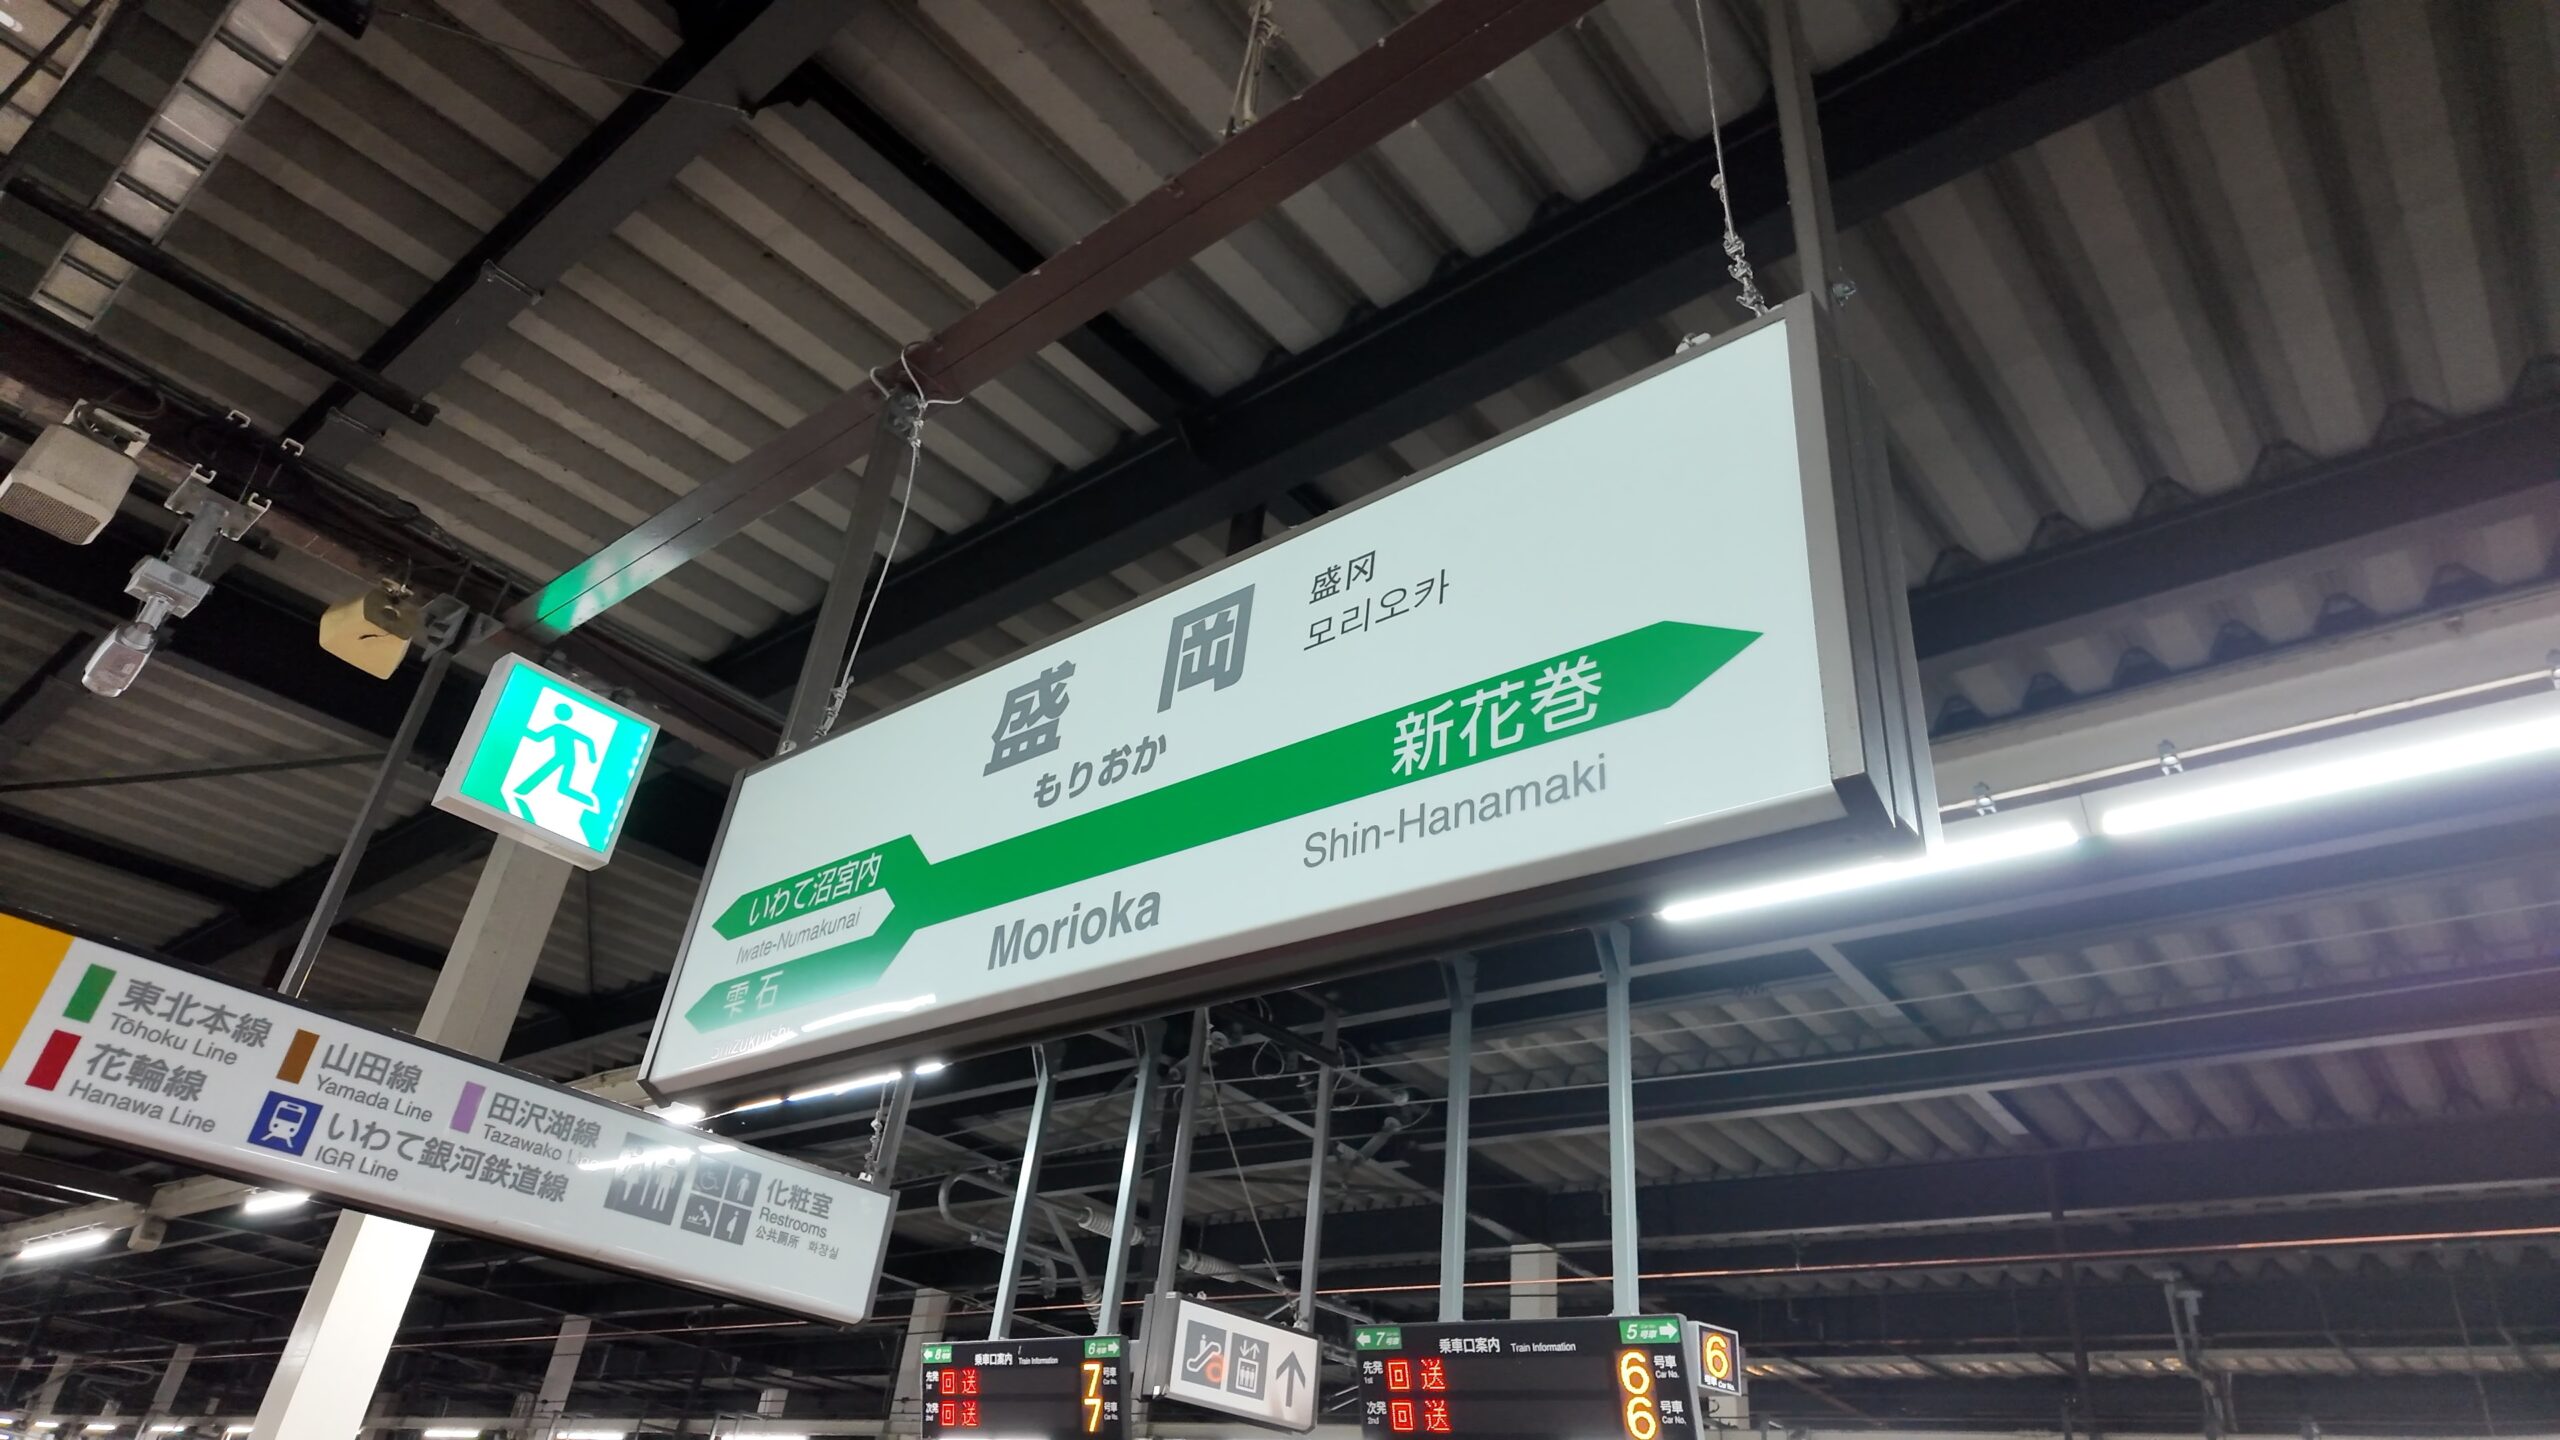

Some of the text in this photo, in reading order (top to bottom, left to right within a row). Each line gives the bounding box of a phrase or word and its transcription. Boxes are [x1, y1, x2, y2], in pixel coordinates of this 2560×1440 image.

[1309, 550, 1376, 604] 盛冈
[1303, 569, 1450, 651] 모리오카
[982, 583, 1256, 777] 盛岡
[1391, 655, 1602, 777] 新花巻
[1033, 733, 1167, 808] もりおか
[1303, 753, 1607, 868] Shin-Hanamaki
[749, 852, 883, 926] いわて沼宮内
[736, 907, 862, 965] Iwate-Numakunai
[987, 890, 1162, 971] Morioka
[118, 978, 274, 1048] 東北本線
[110, 1012, 238, 1066] Tōhoku Line
[87, 1043, 208, 1101] 花輪線
[320, 1043, 423, 1095] 山田線
[68, 1080, 216, 1133] Hanawa Line
[316, 1074, 433, 1123] Yamada Line
[487, 1091, 602, 1149] 田沢湖線
[327, 1112, 569, 1202] いわて銀河鉄道線
[483, 1123, 562, 1161] Tazawako
[315, 1145, 399, 1182] IGR Line
[767, 1178, 833, 1219] 化粧室
[759, 1206, 827, 1238] Restrooms
[1088, 1342, 1096, 1355] 6
[1376, 1332, 1385, 1346] 7
[1439, 1337, 1577, 1354] 乗車口案内 Train Information
[1627, 1324, 1638, 1339] 5
[1363, 1360, 1383, 1375] 先発
[1387, 1359, 1446, 1390] 回送
[1620, 1351, 1650, 1395] 6
[1654, 1355, 1677, 1369] 号車
[1655, 1370, 1667, 1378] Car
[1705, 1334, 1729, 1379] 6
[941, 1369, 977, 1394] 回送
[1083, 1364, 1101, 1397] 7
[941, 1401, 977, 1426] 回送
[1084, 1399, 1101, 1432] 7
[1366, 1401, 1387, 1415] 次発
[1391, 1400, 1450, 1431] 回送
[1626, 1397, 1656, 1440] 6
[1660, 1400, 1683, 1414] 号車
[1661, 1416, 1673, 1424] Car
